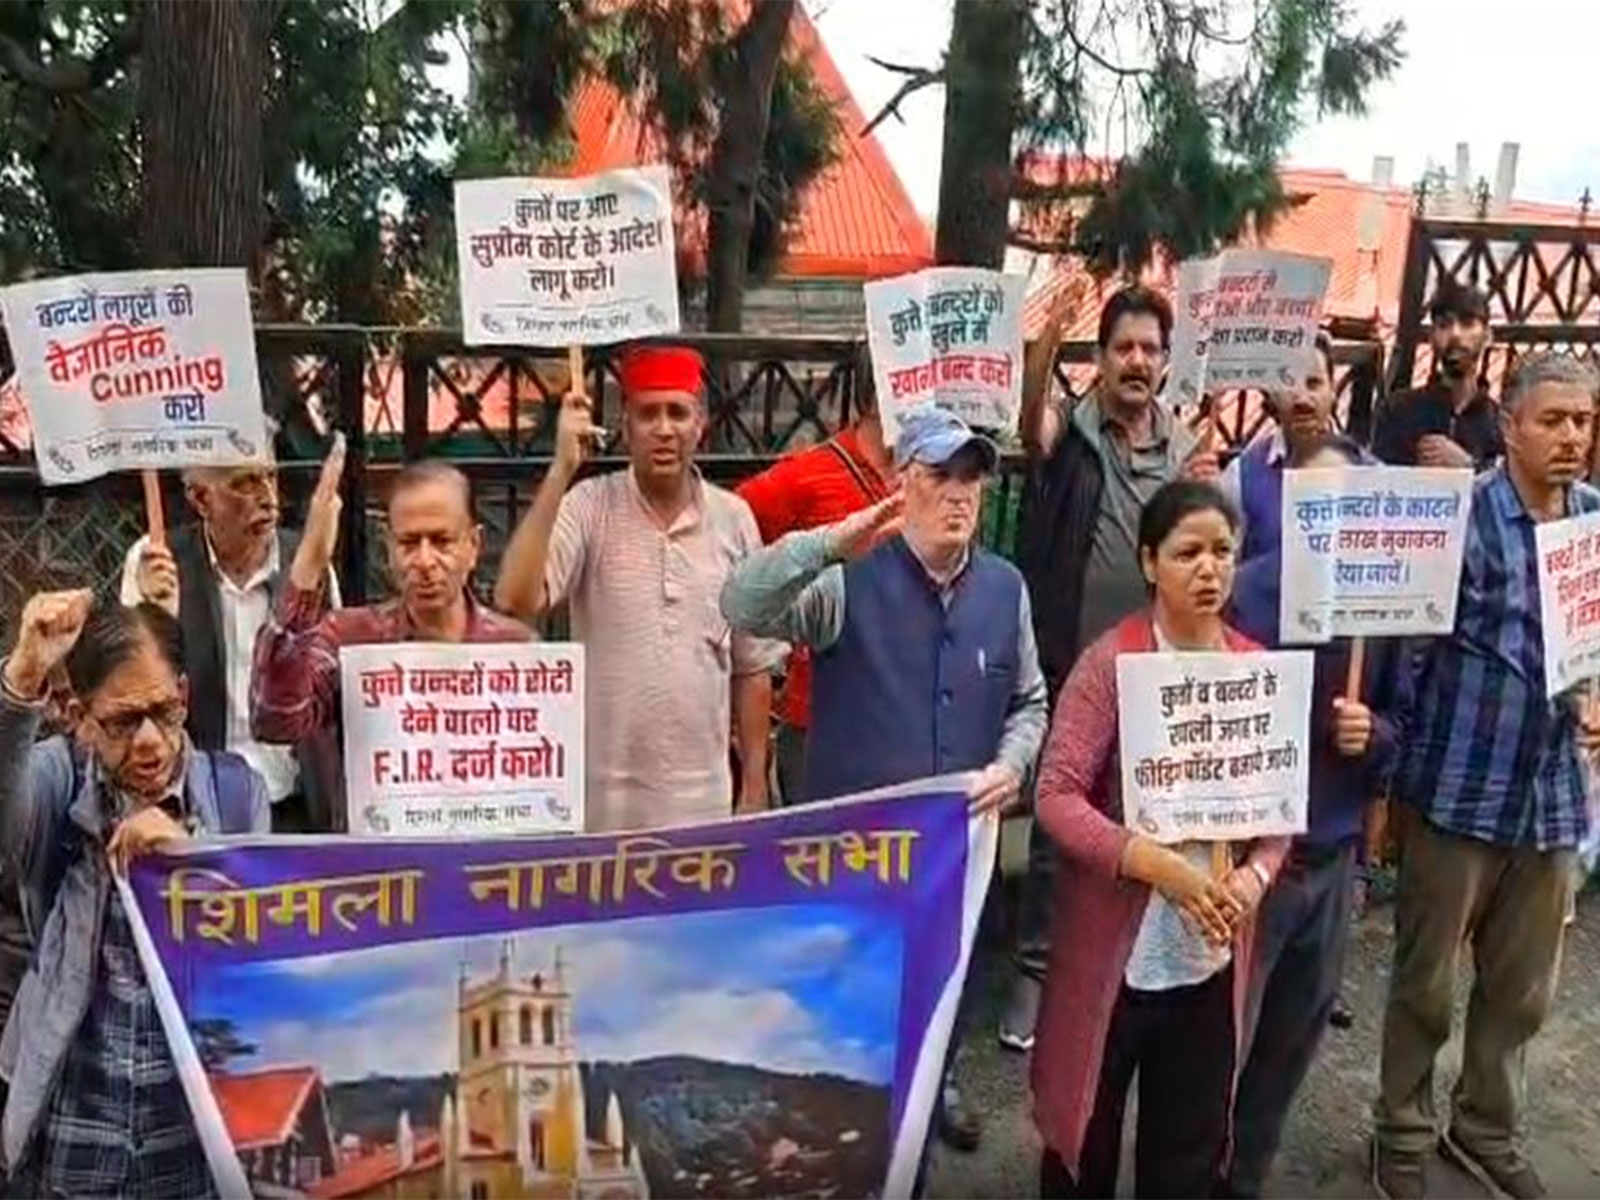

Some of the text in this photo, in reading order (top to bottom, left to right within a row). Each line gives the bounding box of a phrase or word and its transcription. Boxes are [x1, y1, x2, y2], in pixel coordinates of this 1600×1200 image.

[556, 200, 580, 222] पर
[586, 193, 618, 218] आए
[471, 227, 532, 267] सुप्रीम
[537, 228, 577, 259] कोर्ट
[582, 227, 600, 258] के
[166, 284, 193, 317] की
[528, 270, 570, 299] लागू
[91, 356, 223, 401] Cunning
[162, 387, 205, 421] करो
[361, 662, 404, 707] कुत्ते
[489, 662, 518, 693] को
[524, 659, 573, 693] रोटी
[401, 702, 439, 734] देने
[506, 709, 538, 732] पर
[374, 749, 442, 785] F.I.R.
[451, 742, 496, 781] दर्ज
[160, 829, 920, 945] शिमला नागरिक सभा
